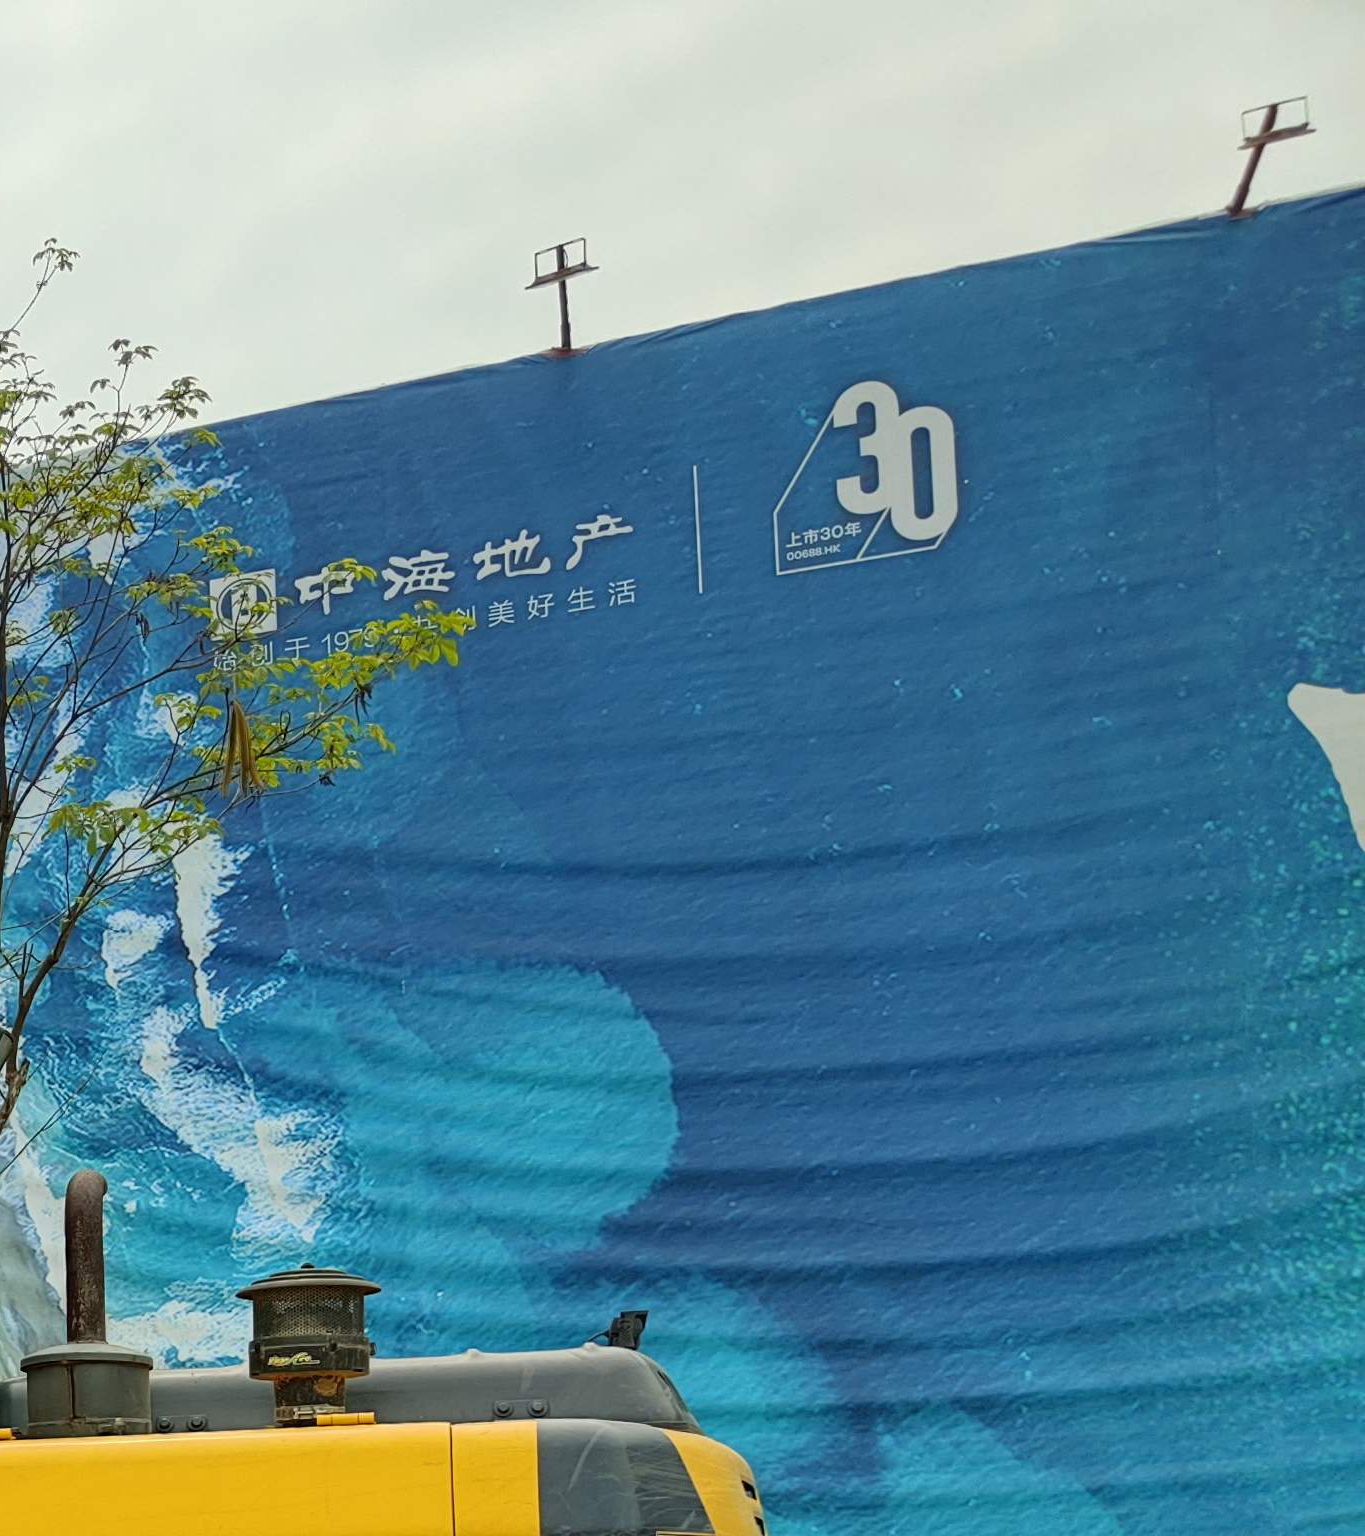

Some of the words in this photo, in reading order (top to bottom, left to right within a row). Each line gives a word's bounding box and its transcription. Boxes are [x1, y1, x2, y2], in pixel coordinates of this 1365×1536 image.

[833, 380, 958, 540] 30
[294, 514, 634, 615] 中海地产
[785, 521, 862, 548] 上市30年
[786, 544, 841, 561] 00688.HK
